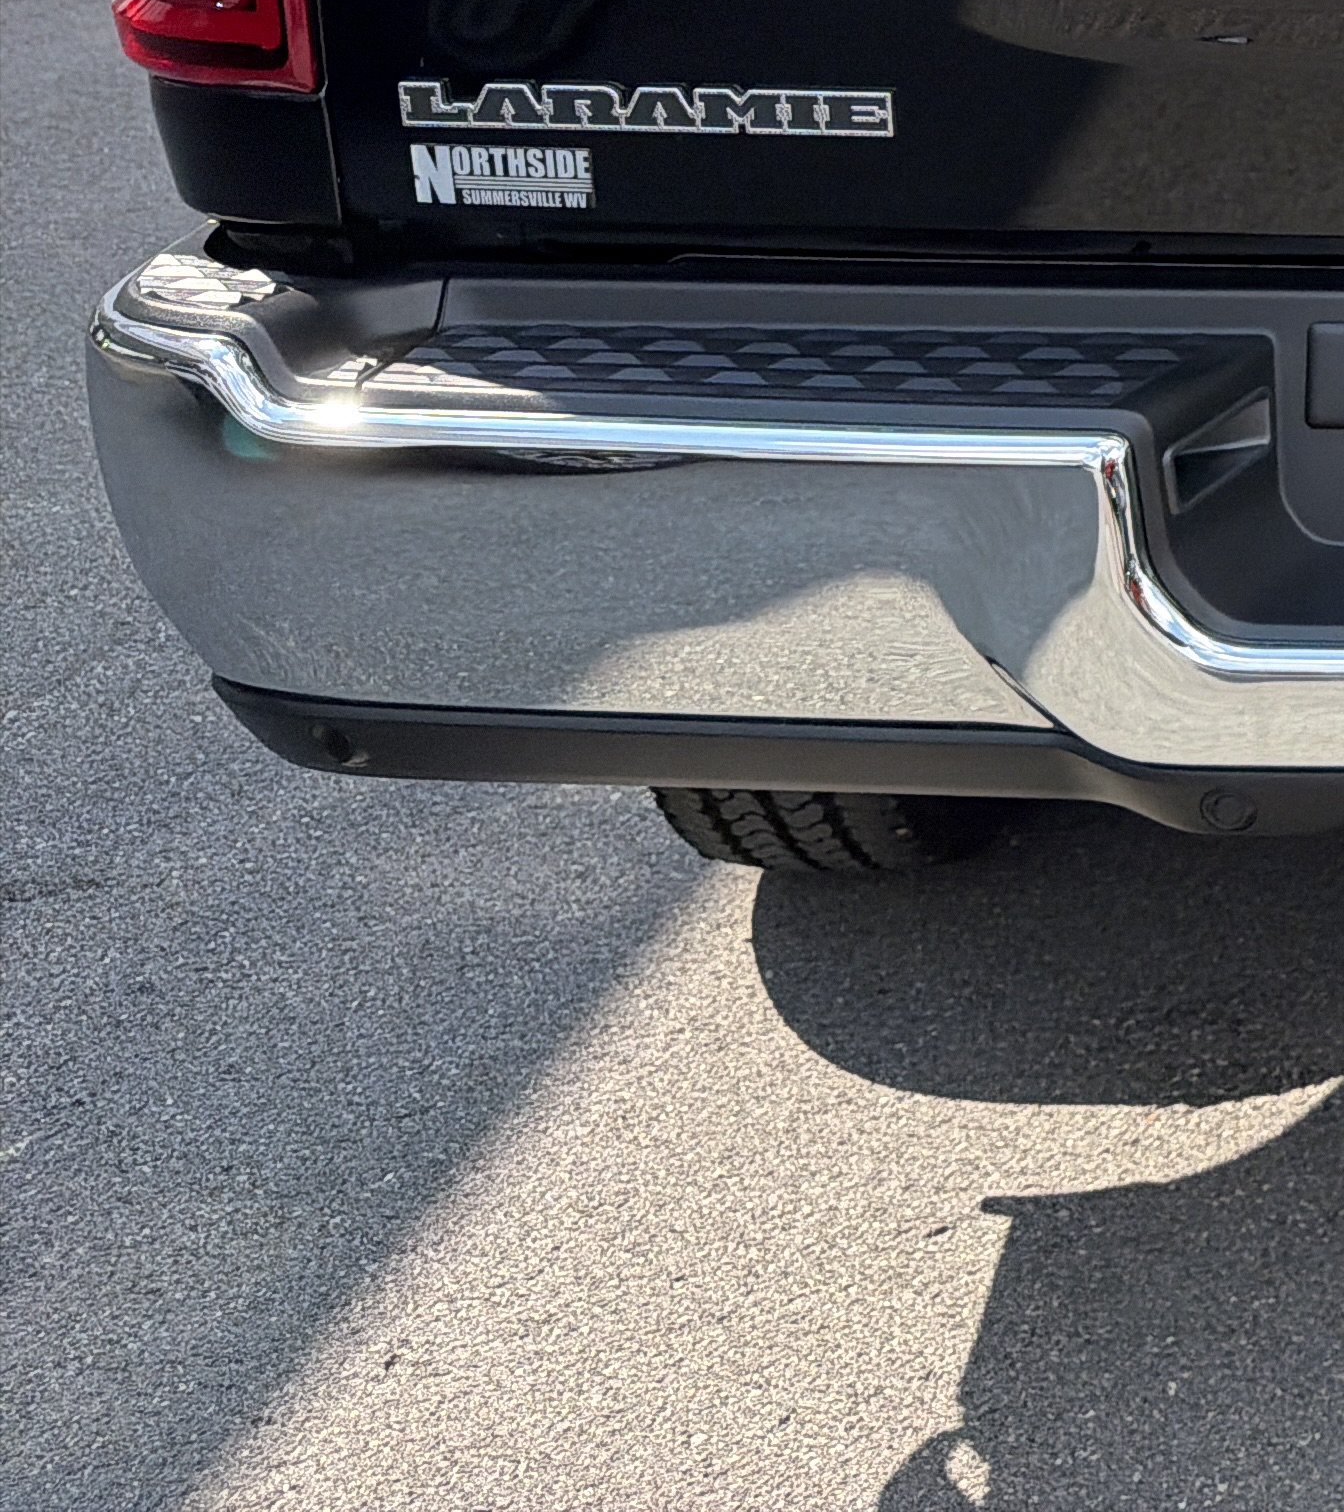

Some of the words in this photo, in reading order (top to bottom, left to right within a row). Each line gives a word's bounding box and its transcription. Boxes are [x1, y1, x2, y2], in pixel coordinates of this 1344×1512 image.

[398, 80, 895, 138] LARAMIE
[410, 143, 593, 205] NORTHSIDE
[461, 189, 563, 208] SUMMERSVILLE
[563, 192, 588, 209] WV
